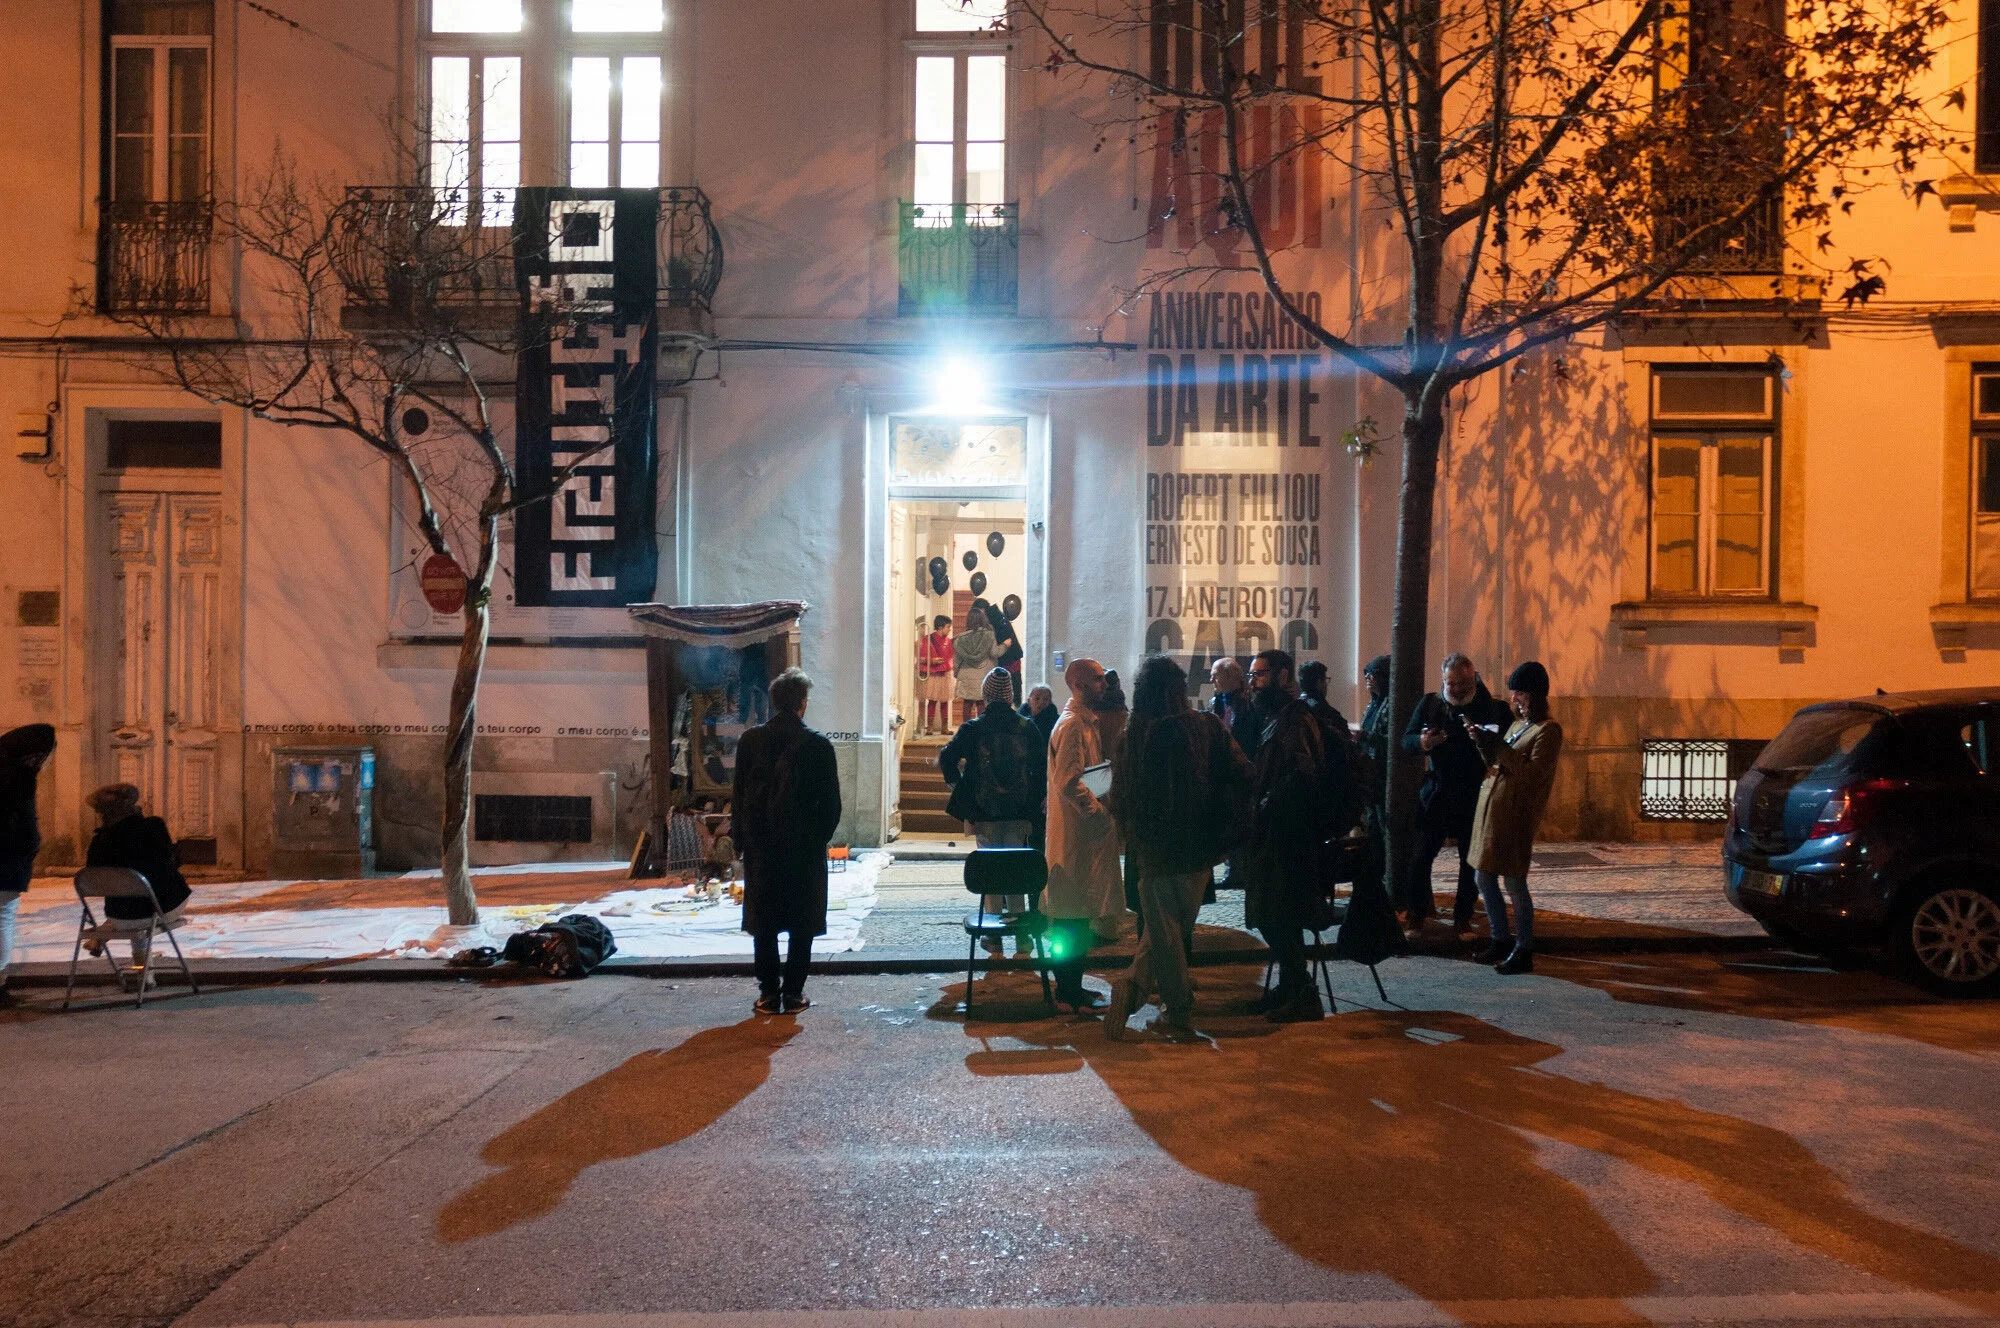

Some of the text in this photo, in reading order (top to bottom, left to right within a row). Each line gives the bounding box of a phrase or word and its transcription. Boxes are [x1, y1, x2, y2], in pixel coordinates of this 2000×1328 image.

[1145, 105, 1322, 268] AQUI
[1147, 353, 1321, 447] DA ARTE
[1146, 472, 1321, 522] ROBERT FILLIOU
[1146, 524, 1321, 566] ERNESTO DE SOUSA
[282, 725, 314, 734] corpo
[337, 723, 355, 733] teu
[358, 725, 390, 734] corpo
[405, 725, 428, 733] meu
[488, 724, 505, 733] teu
[508, 725, 541, 734] corpo
[568, 727, 592, 735] meu
[596, 727, 628, 736] corpo
[826, 731, 859, 740] corpo
